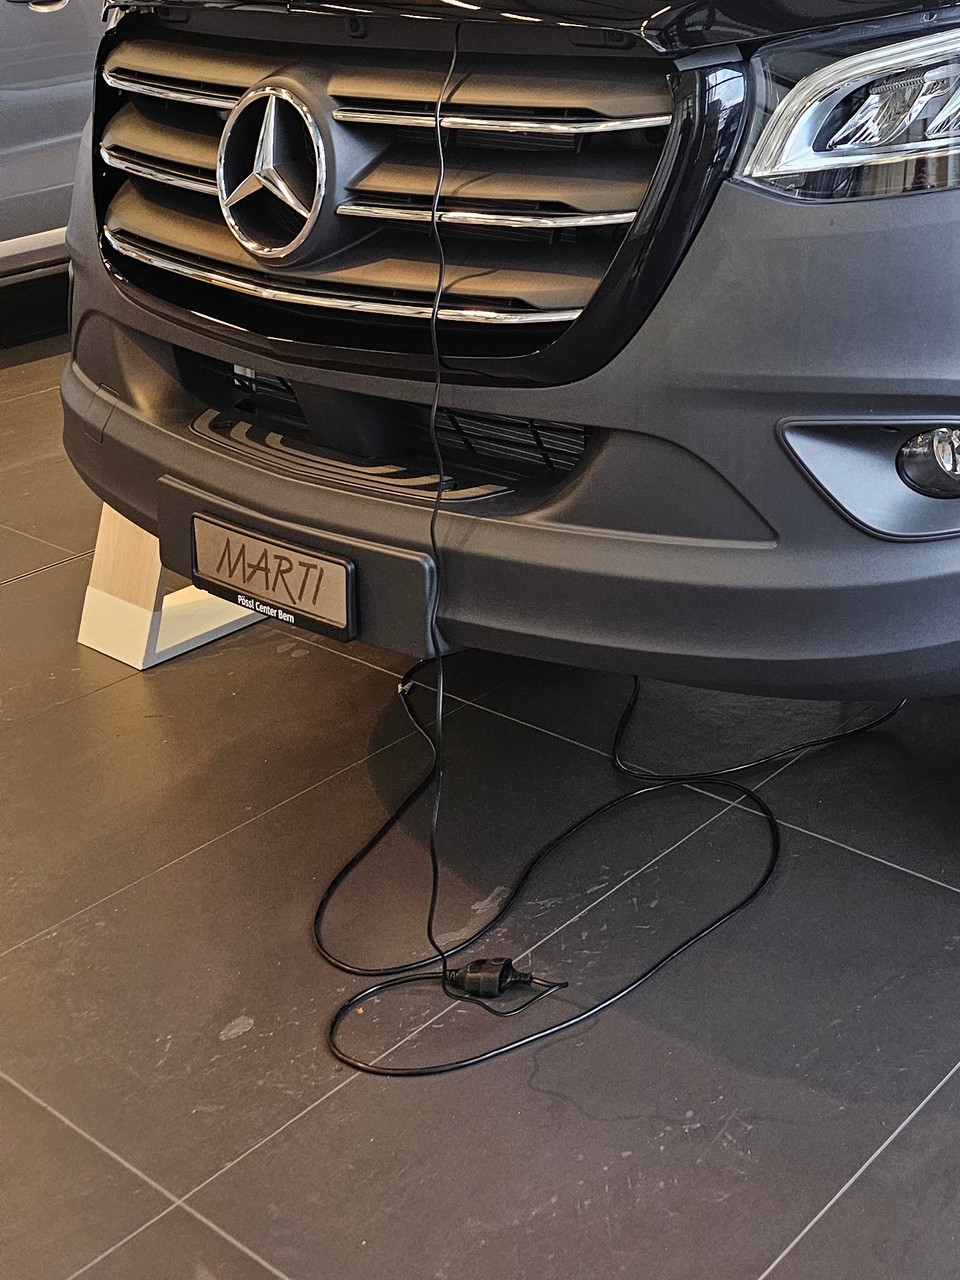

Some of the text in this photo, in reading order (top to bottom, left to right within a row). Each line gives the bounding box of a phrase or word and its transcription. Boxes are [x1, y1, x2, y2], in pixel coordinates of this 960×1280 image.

[216, 537, 325, 606] MARTI
[237, 594, 295, 624] Pössl Center Bern
